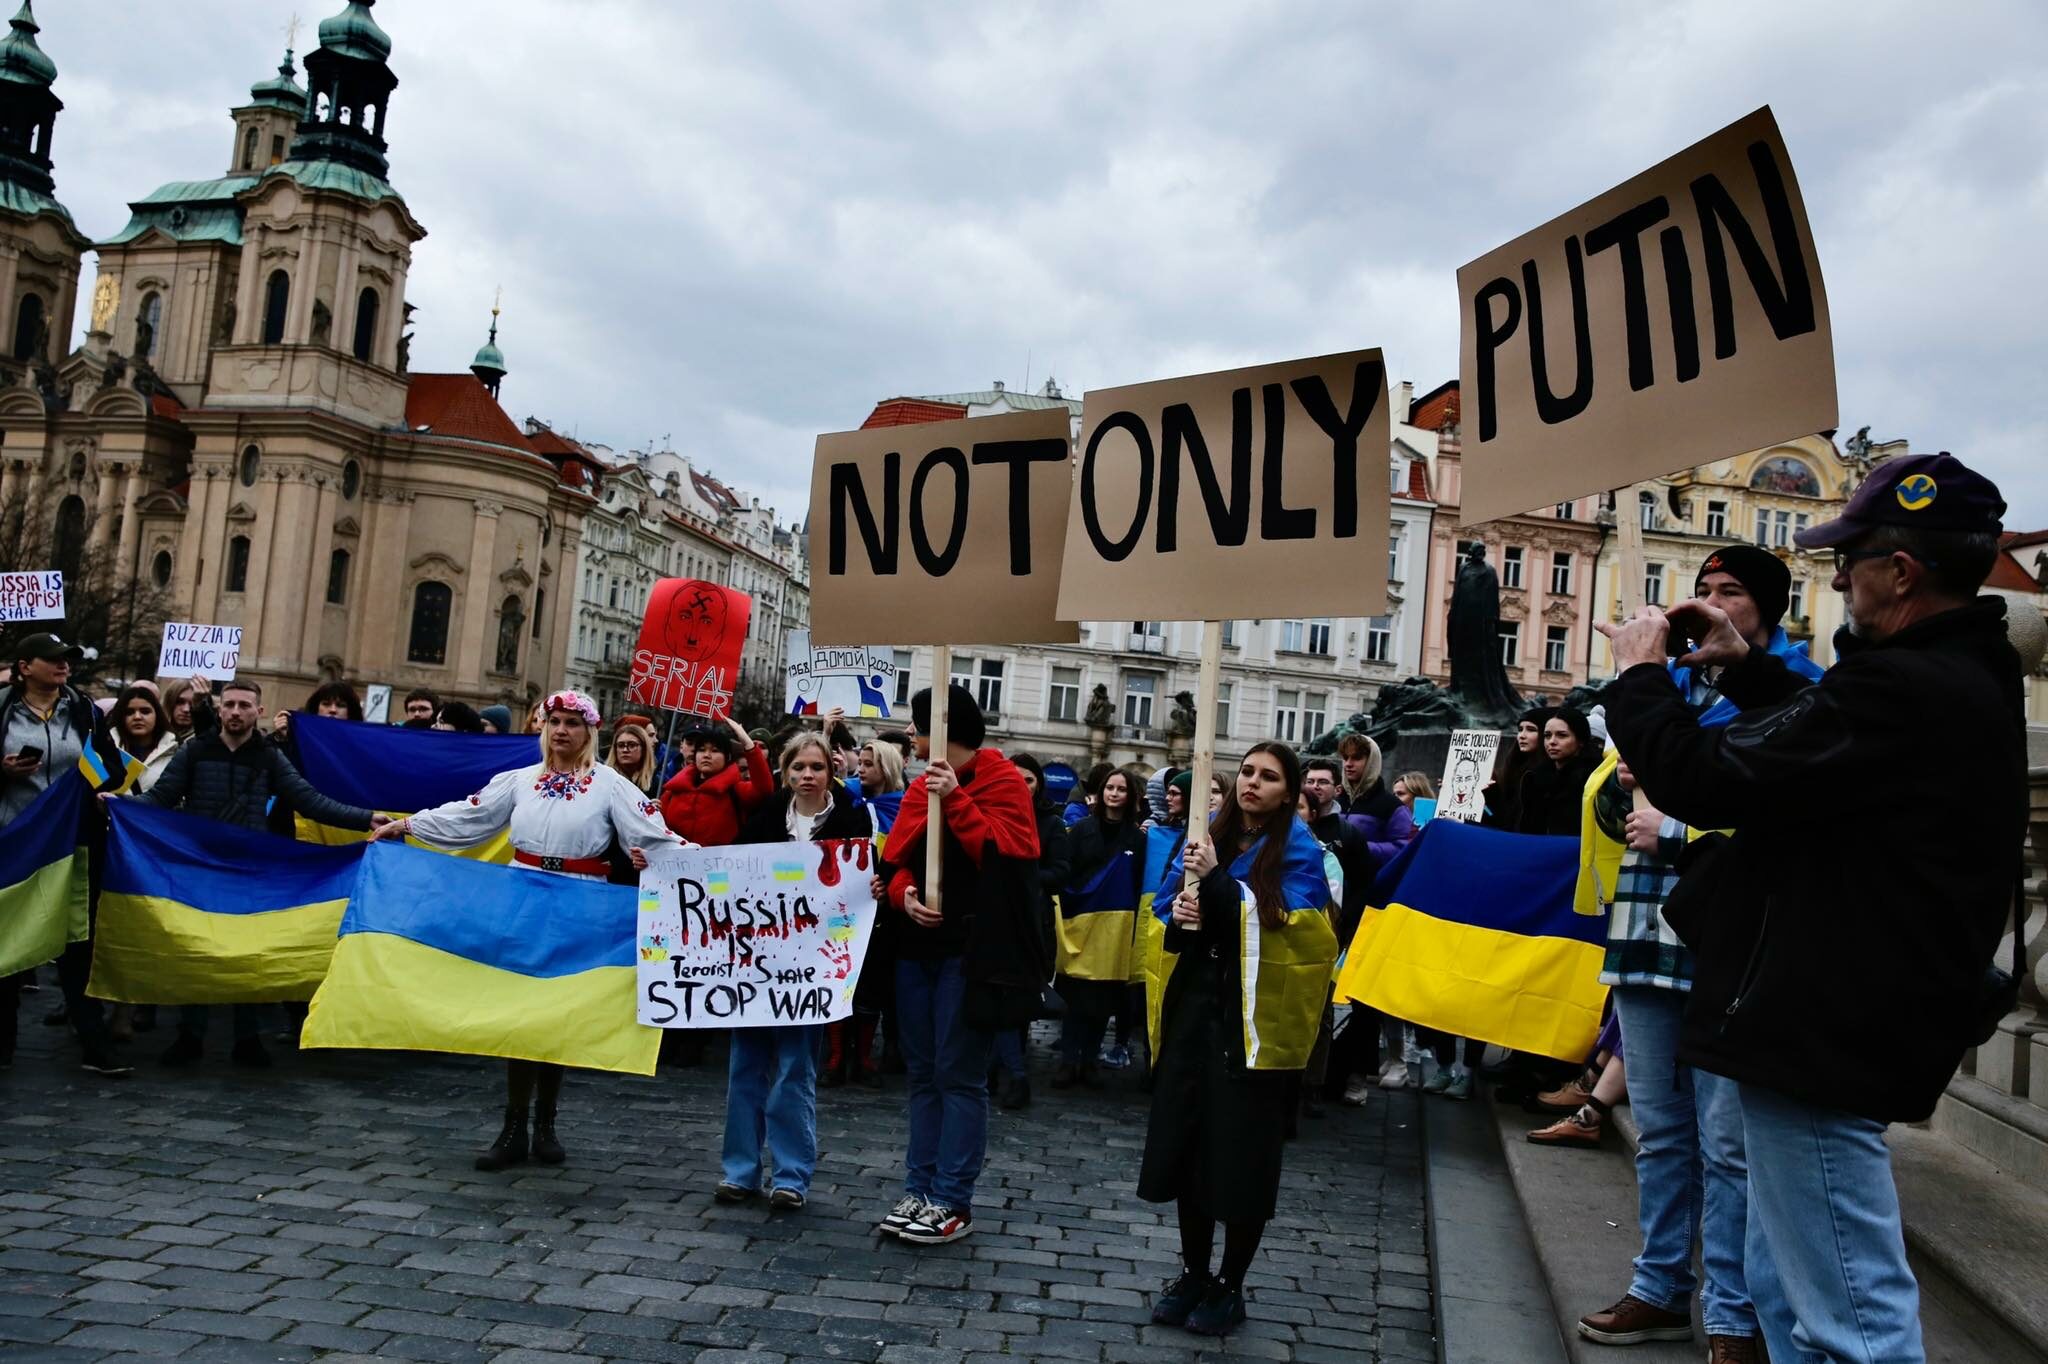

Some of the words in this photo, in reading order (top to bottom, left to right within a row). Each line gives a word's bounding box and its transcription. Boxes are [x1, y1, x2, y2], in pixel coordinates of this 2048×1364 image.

[1474, 140, 1816, 442] PUTIN
[1080, 360, 1382, 562] ONLY
[829, 438, 1068, 577] NOT
[46, 573, 62, 590] IS
[168, 625, 223, 643] RUZZIA
[229, 628, 242, 645] IS
[164, 648, 215, 669] KILLING
[222, 651, 239, 669] US
[815, 650, 866, 668] ДОМОЙ
[869, 657, 897, 676] 2023
[632, 649, 733, 696] SERIAL
[788, 662, 809, 677] 1968
[627, 674, 729, 719] KILLER
[1452, 733, 1470, 746] HAVE
[1471, 734, 1485, 747] YOU
[1455, 749, 1472, 761] THIS
[648, 980, 757, 1024] STOP
[768, 986, 833, 1021] WAR
